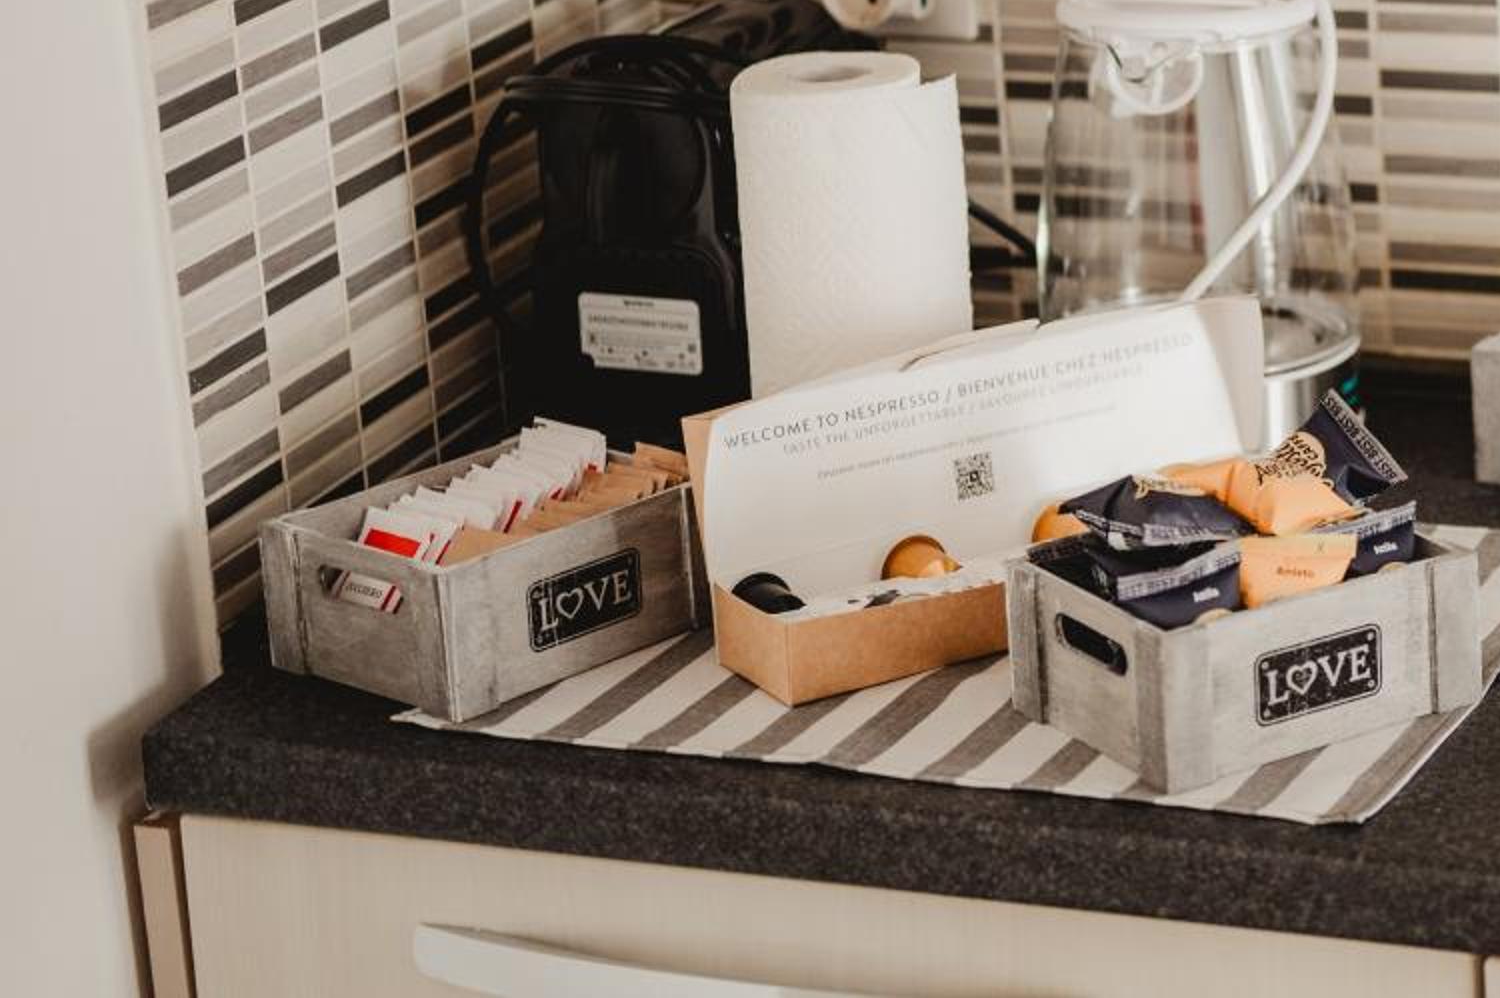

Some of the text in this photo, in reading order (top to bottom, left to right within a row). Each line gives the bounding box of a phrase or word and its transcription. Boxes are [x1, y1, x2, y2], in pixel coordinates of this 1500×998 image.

[723, 418, 810, 450] WELCOME
[816, 411, 840, 430] TO
[844, 389, 940, 423] NESPRESSO
[956, 364, 1050, 398] BIENVENUE
[1054, 351, 1097, 376] CHEZ
[1265, 644, 1371, 706] LOVE
